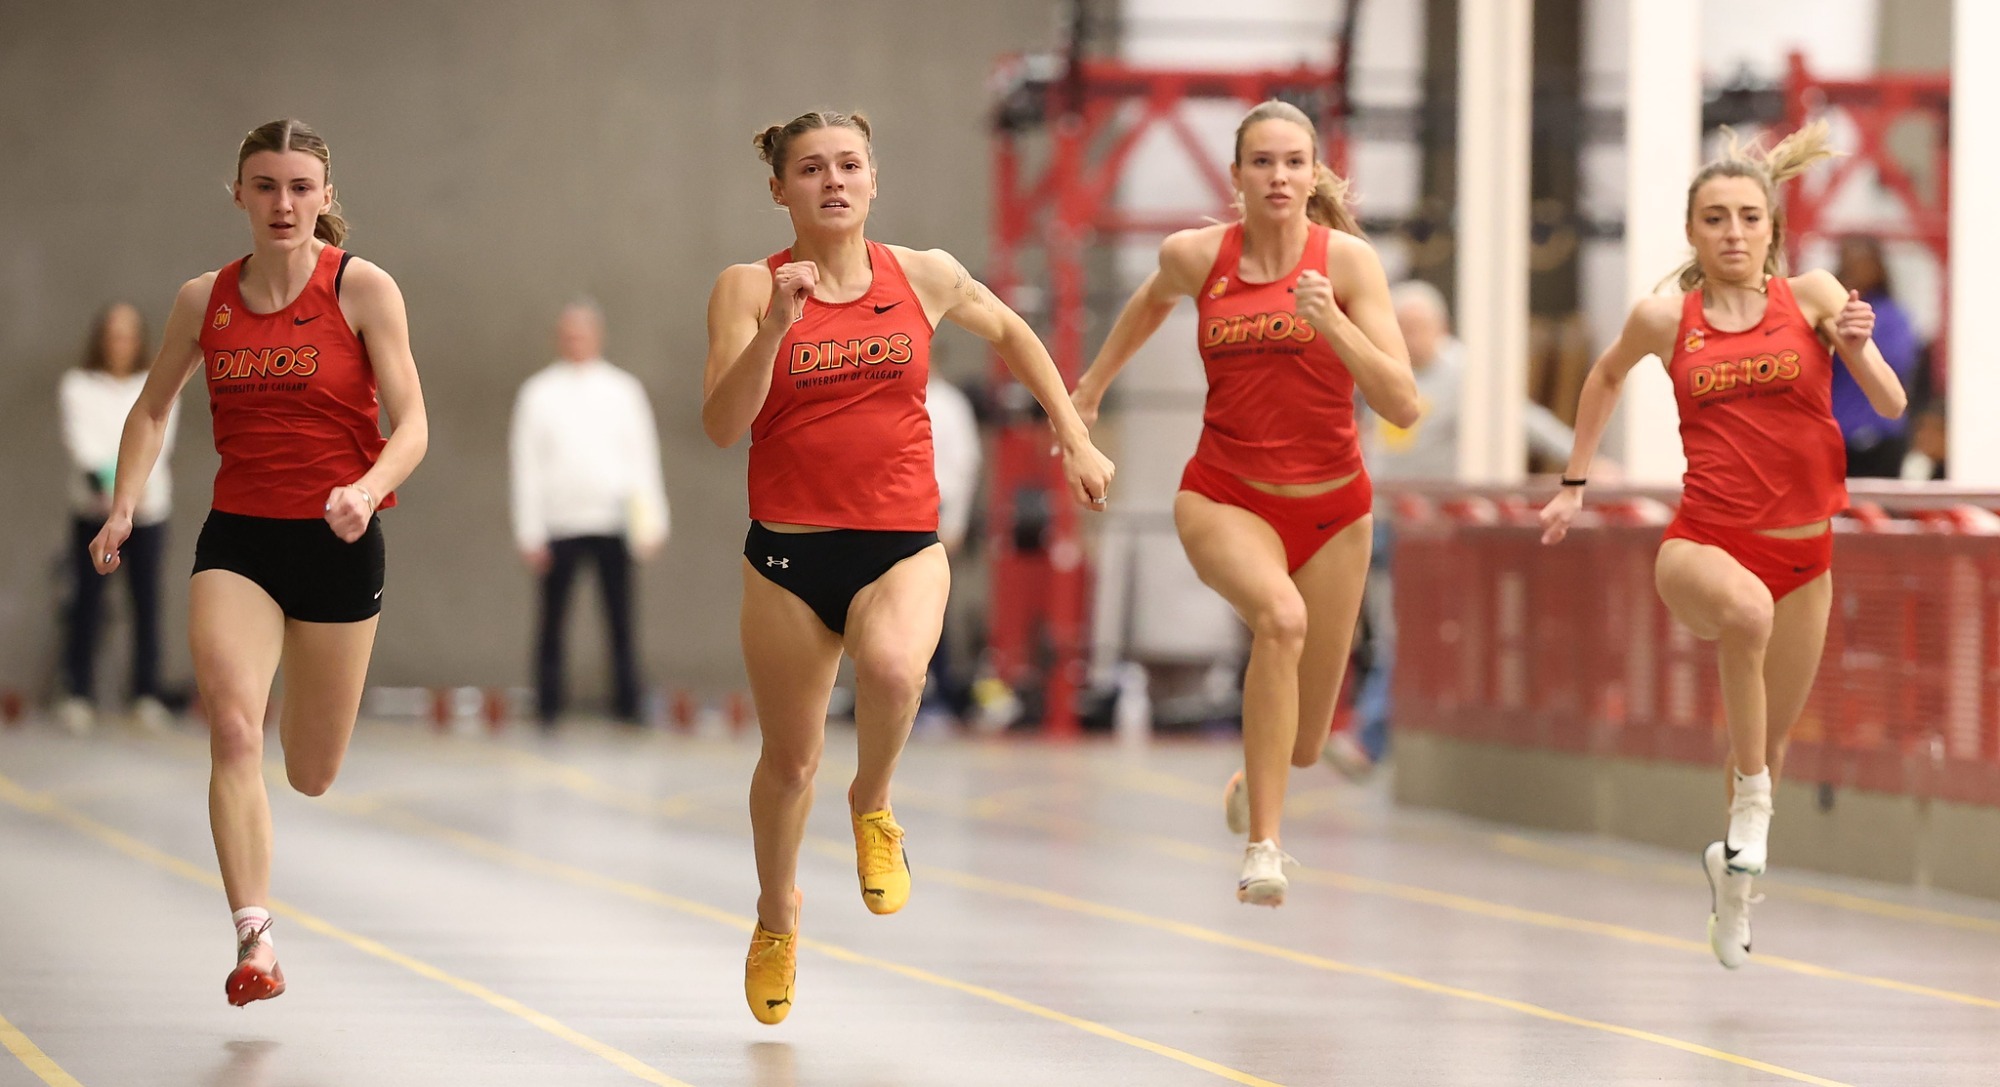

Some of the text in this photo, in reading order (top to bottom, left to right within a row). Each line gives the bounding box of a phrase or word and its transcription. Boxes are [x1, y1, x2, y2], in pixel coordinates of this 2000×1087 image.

[1203, 311, 1317, 350] DINOS
[211, 345, 320, 381] DINOS
[790, 332, 912, 375] DINOS
[796, 370, 904, 389] UNIVERSITY OF CALGARY
[1689, 349, 1801, 398] DINOS
